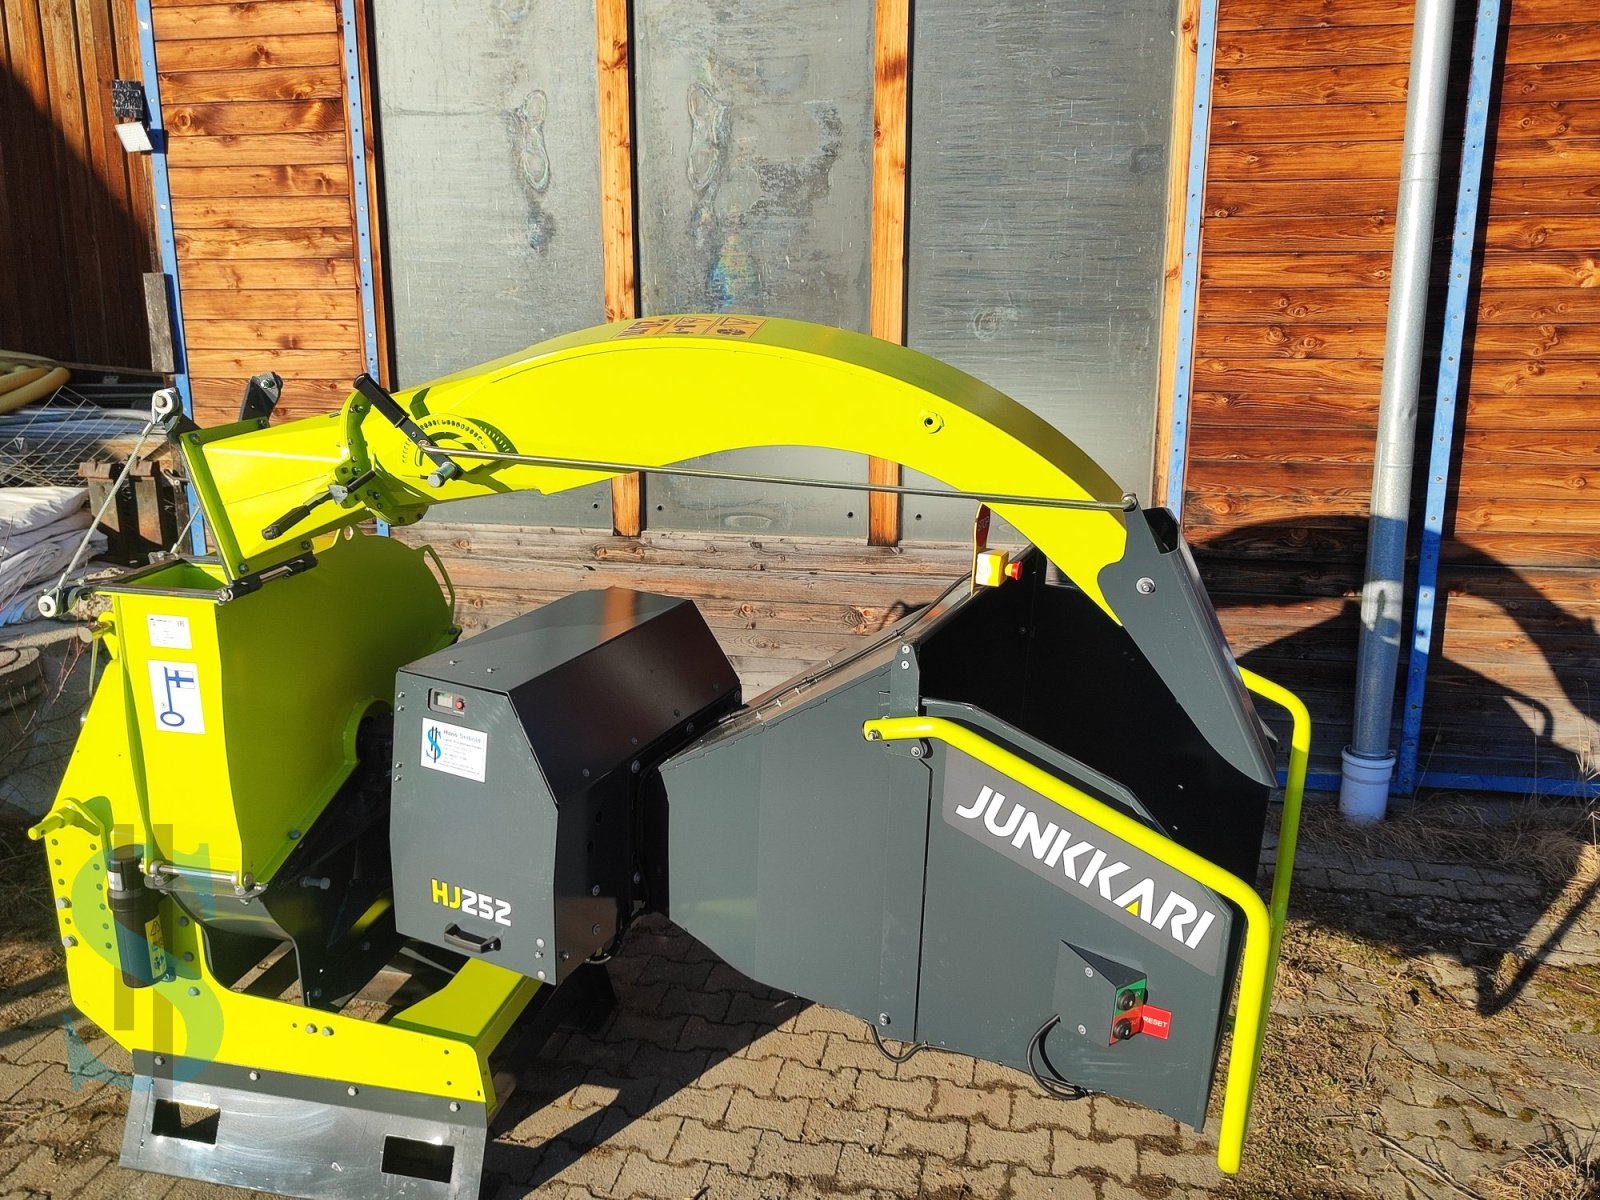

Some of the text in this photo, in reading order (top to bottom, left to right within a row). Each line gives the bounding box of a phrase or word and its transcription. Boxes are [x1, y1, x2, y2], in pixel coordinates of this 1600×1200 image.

[955, 785, 1216, 950] JUNKKARI
[431, 879, 511, 926] HJ252
[1143, 1016, 1168, 1028] RESET
